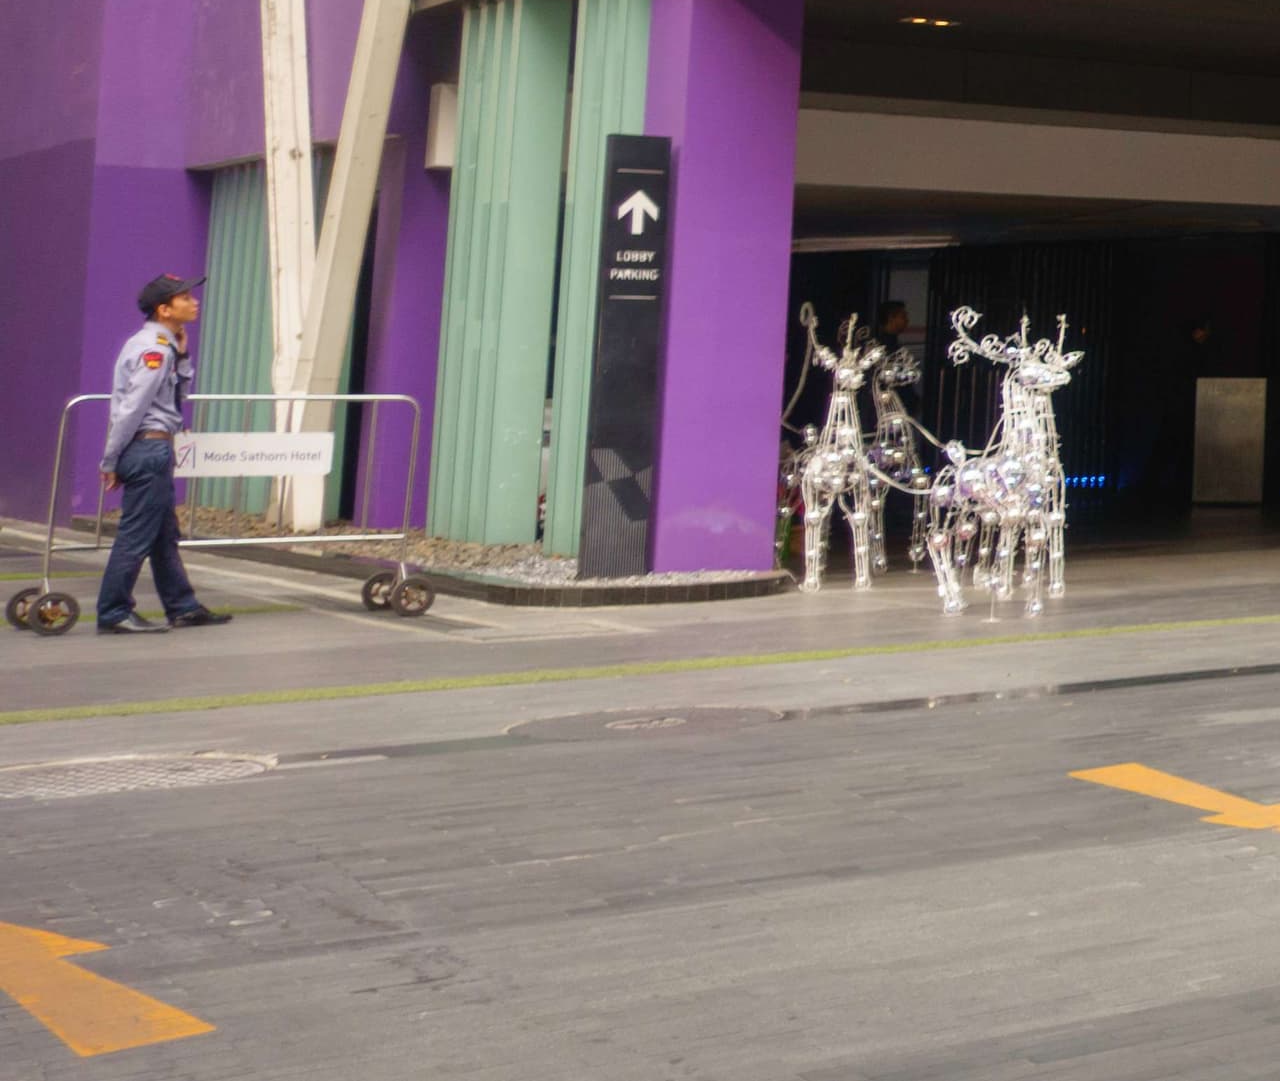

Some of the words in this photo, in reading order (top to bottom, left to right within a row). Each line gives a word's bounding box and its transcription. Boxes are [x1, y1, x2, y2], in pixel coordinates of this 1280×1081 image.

[616, 250, 656, 263] LOBBY
[609, 268, 659, 281] PARKING
[204, 451, 235, 462] Mode
[239, 451, 287, 462] Sathorn
[290, 450, 321, 461] Hotel
